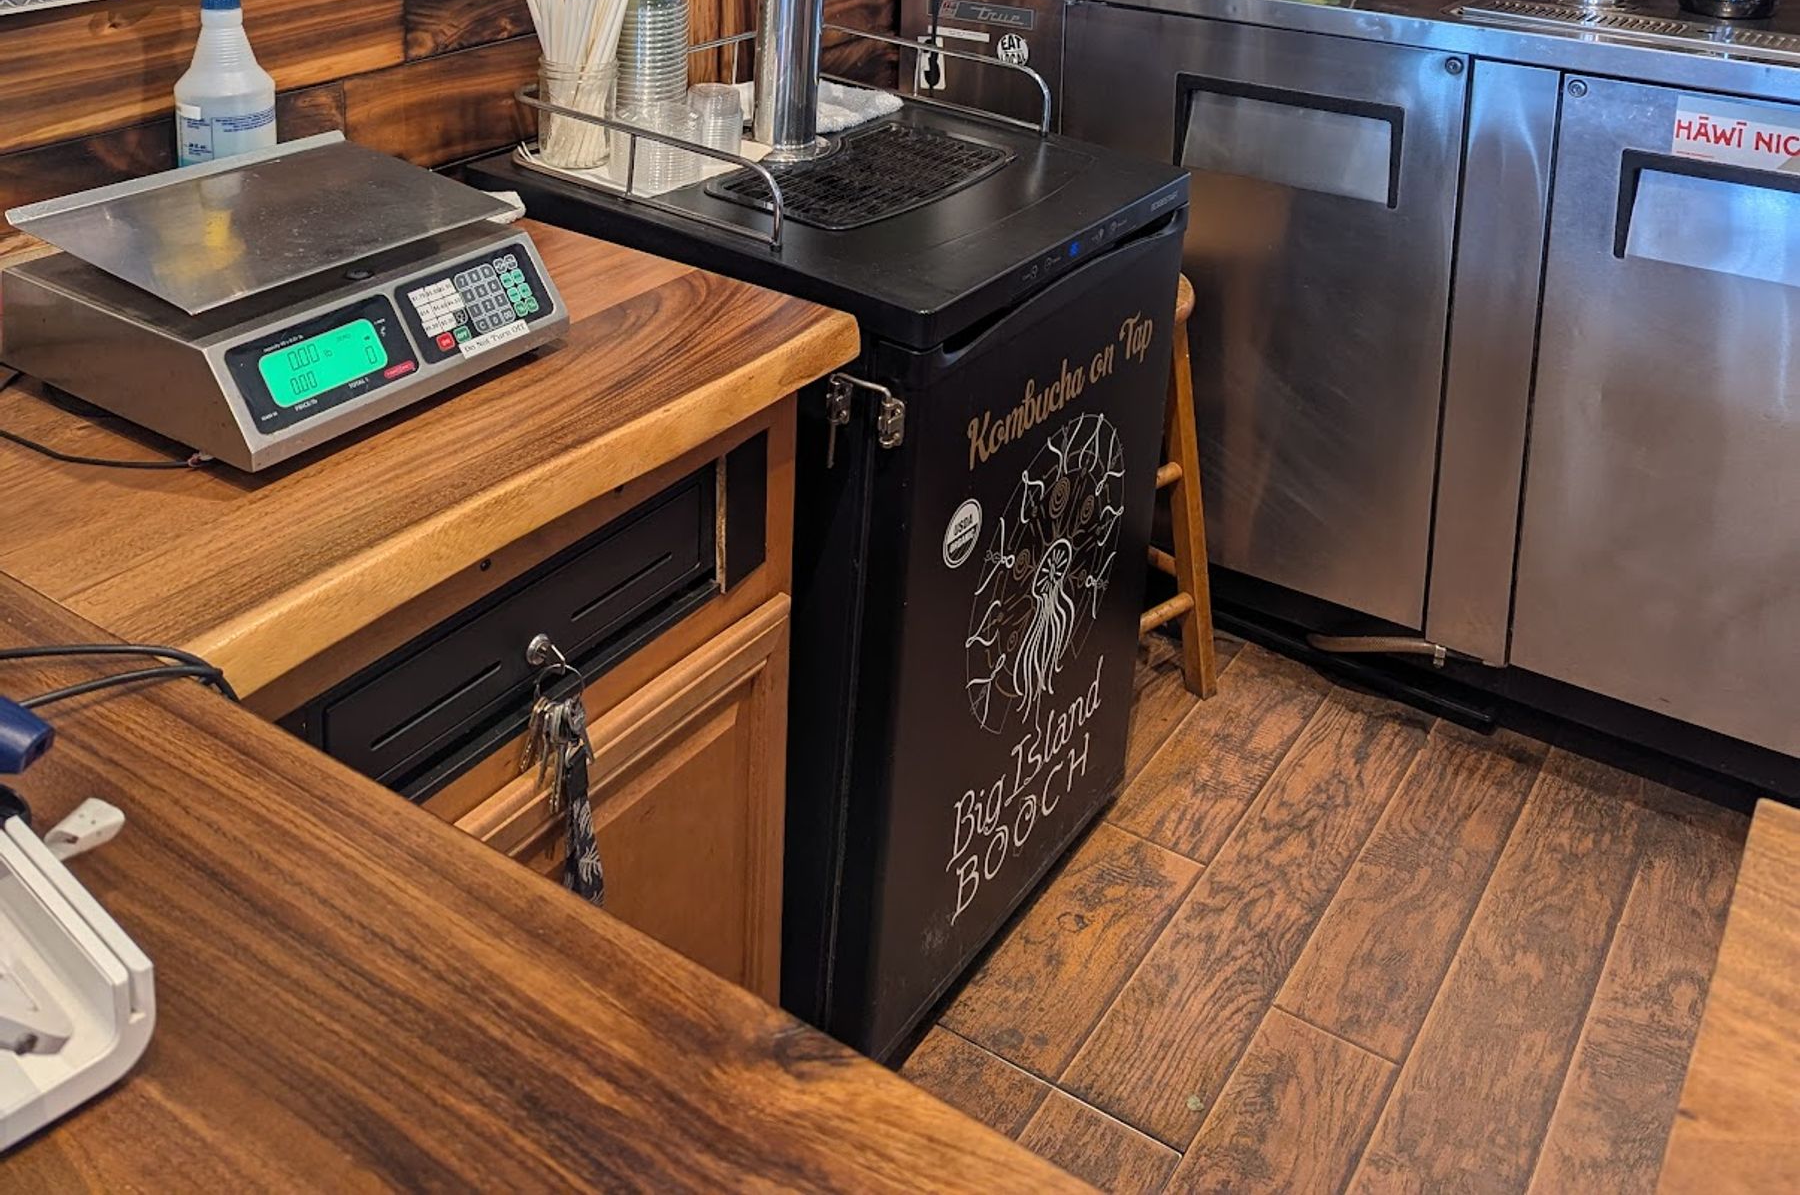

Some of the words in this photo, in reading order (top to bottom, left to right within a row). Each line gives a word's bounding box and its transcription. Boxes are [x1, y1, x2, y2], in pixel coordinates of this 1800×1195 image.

[1001, 35, 1022, 51] EAT
[1754, 130, 1800, 157] NIC
[967, 357, 1085, 471] Kombucha
[1089, 343, 1115, 384] on
[1119, 310, 1153, 363] Tap
[946, 773, 1006, 872] Big
[1004, 655, 1104, 807] Island
[951, 732, 1090, 927] BOOCH
